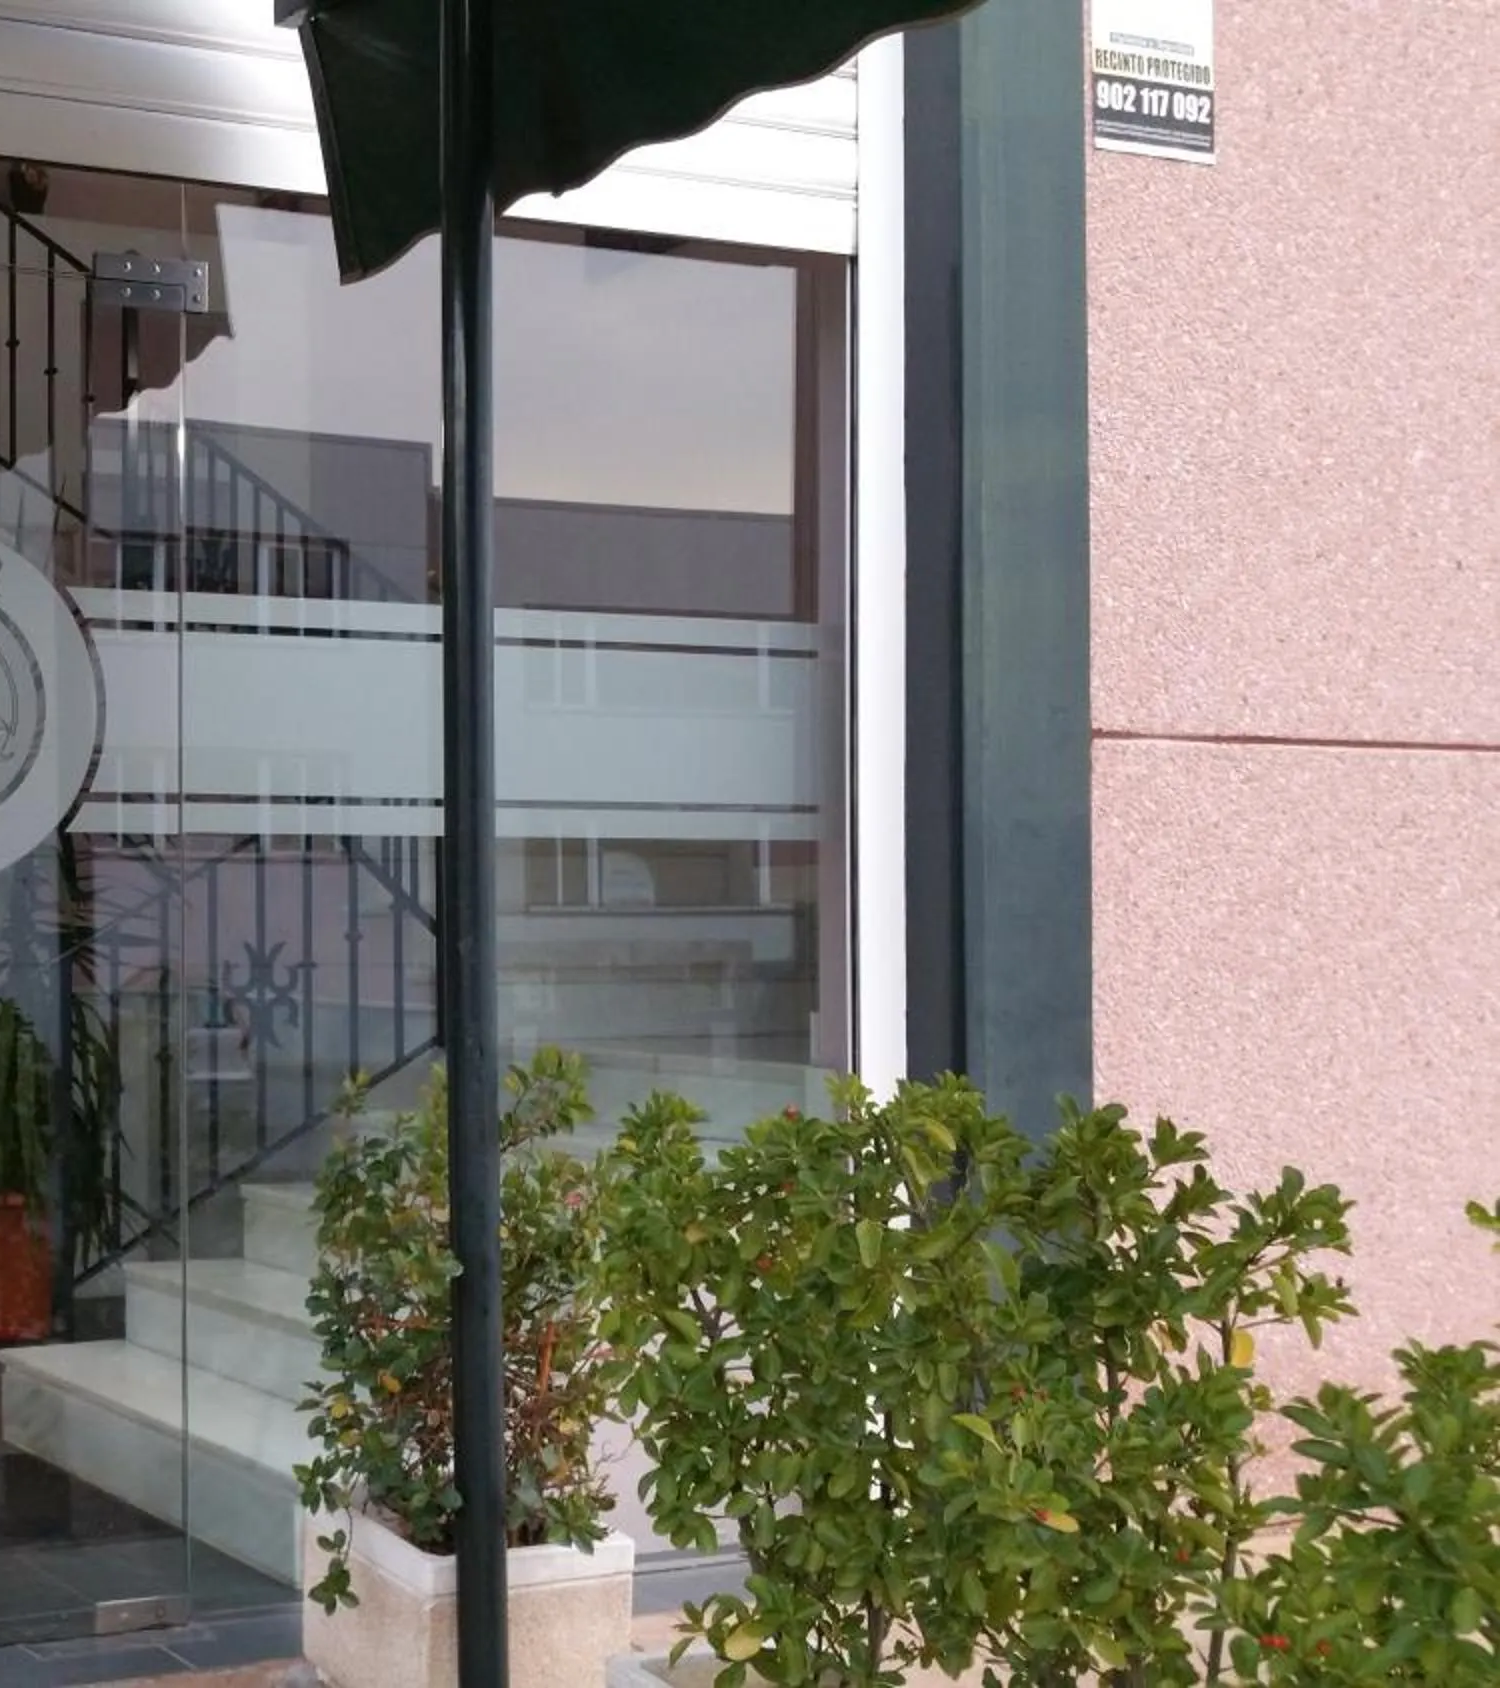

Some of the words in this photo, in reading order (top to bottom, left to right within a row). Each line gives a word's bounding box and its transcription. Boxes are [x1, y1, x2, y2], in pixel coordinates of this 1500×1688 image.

[1094, 48, 1145, 75] RECINTO
[1146, 56, 1211, 85] PROTEGIDO
[1096, 80, 1137, 112] 902
[1140, 87, 1170, 117] 117
[1173, 91, 1211, 123] 092
